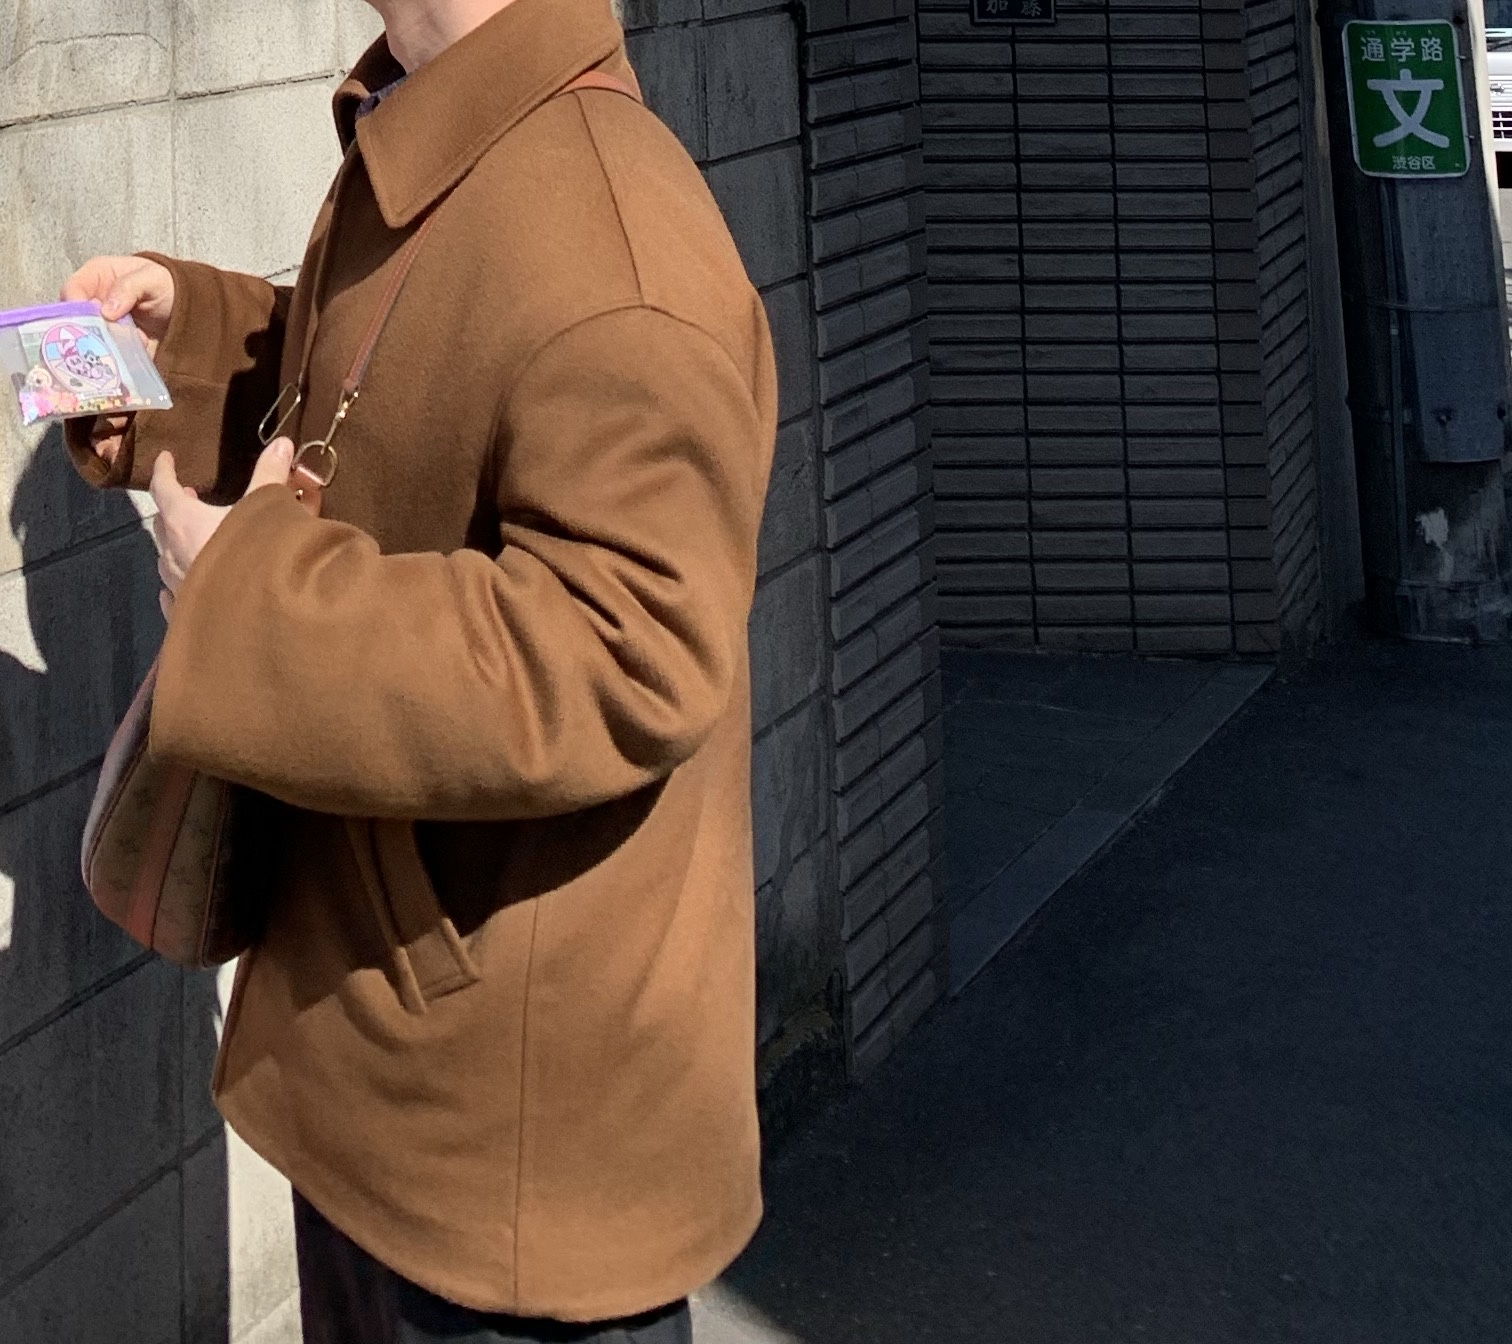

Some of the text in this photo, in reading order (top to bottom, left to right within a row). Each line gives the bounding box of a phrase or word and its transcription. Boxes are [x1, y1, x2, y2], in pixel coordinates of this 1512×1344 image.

[1360, 36, 1443, 62] 通学路
[1366, 68, 1450, 148] 文
[1392, 155, 1436, 170] 渋谷区
